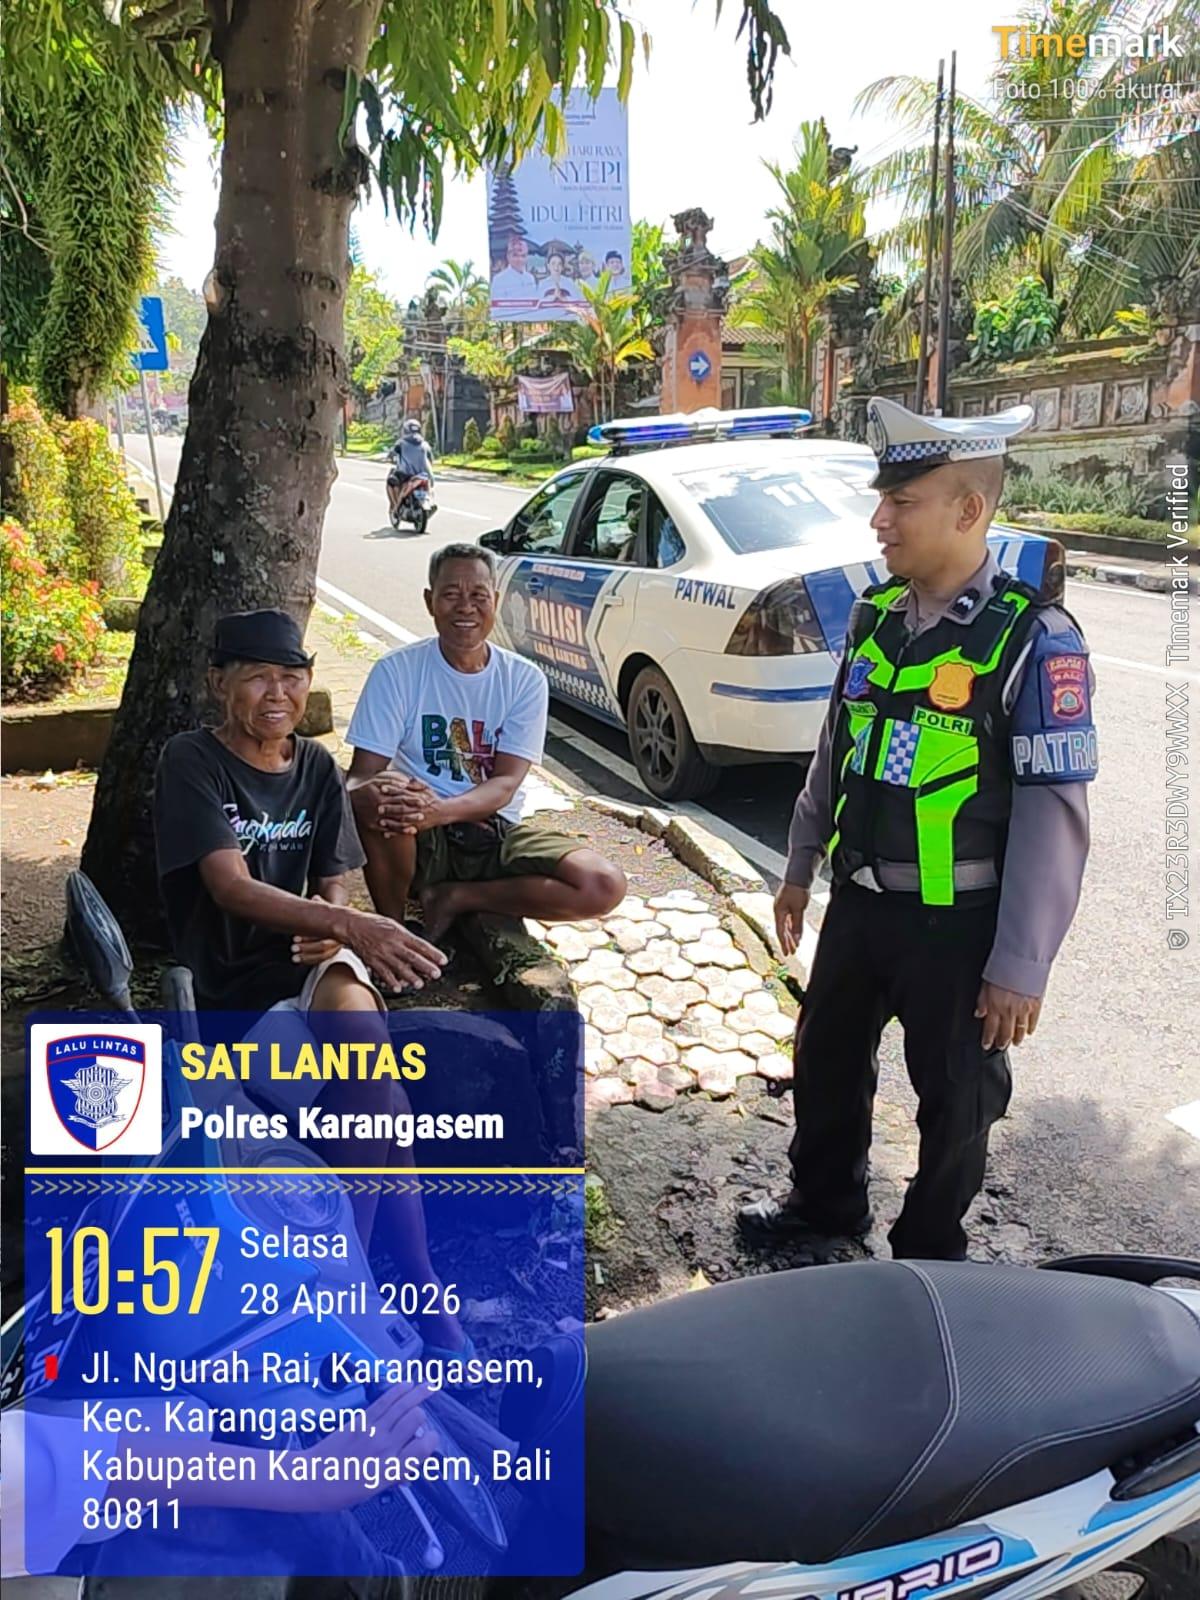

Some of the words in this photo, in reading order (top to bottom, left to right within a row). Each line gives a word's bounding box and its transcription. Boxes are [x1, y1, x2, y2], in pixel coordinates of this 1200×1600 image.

[553, 161, 621, 183] NYEPI
[531, 205, 573, 222] IDUL
[578, 205, 623, 222] FITRI
[674, 578, 736, 610] PATWAL
[529, 597, 584, 646] POLISI
[916, 710, 971, 735] POLRI
[838, 1539, 1002, 1600] ARIO
